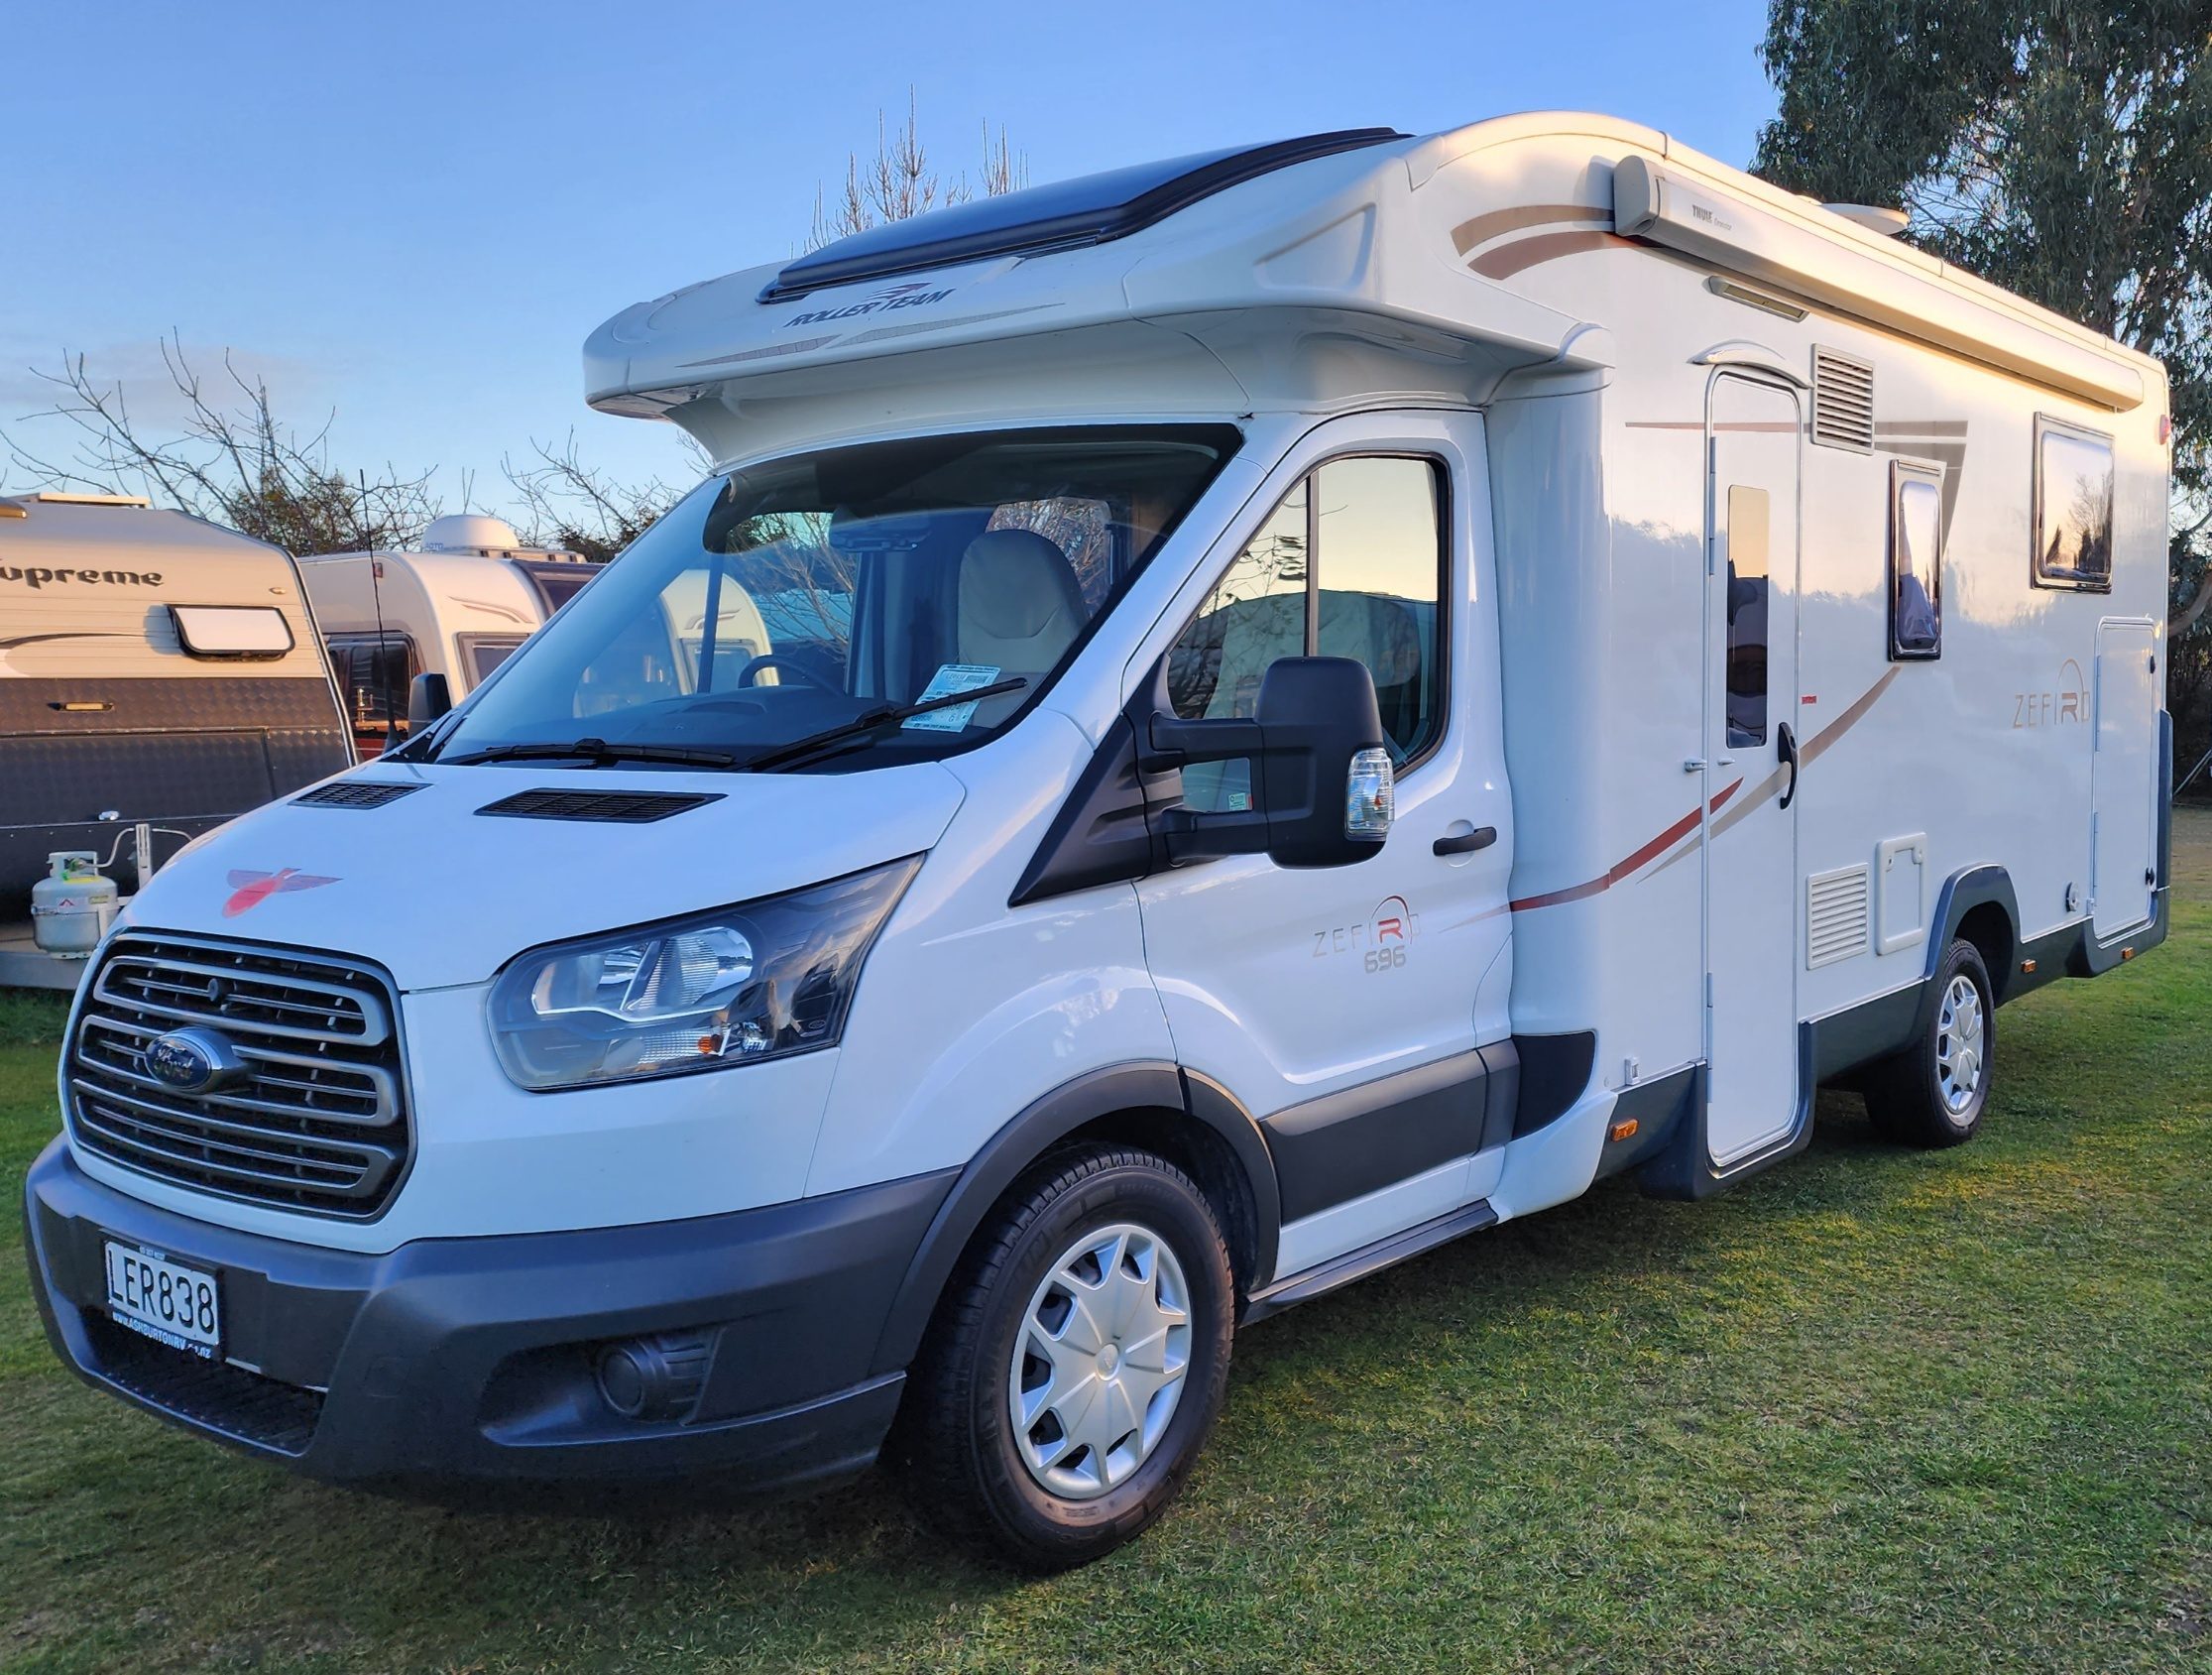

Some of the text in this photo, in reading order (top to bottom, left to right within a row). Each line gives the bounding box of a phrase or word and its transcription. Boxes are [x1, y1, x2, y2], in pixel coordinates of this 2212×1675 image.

[1691, 203, 1712, 223] THULE
[782, 288, 958, 328] ROLLER TEAM
[0, 565, 165, 590] upreme
[2012, 688, 2091, 730] ZEFIRO
[1312, 910, 1421, 958] ZEFIRO
[1364, 945, 1407, 973] 696
[155, 1043, 196, 1070] Ford
[107, 1249, 215, 1335] LER838
